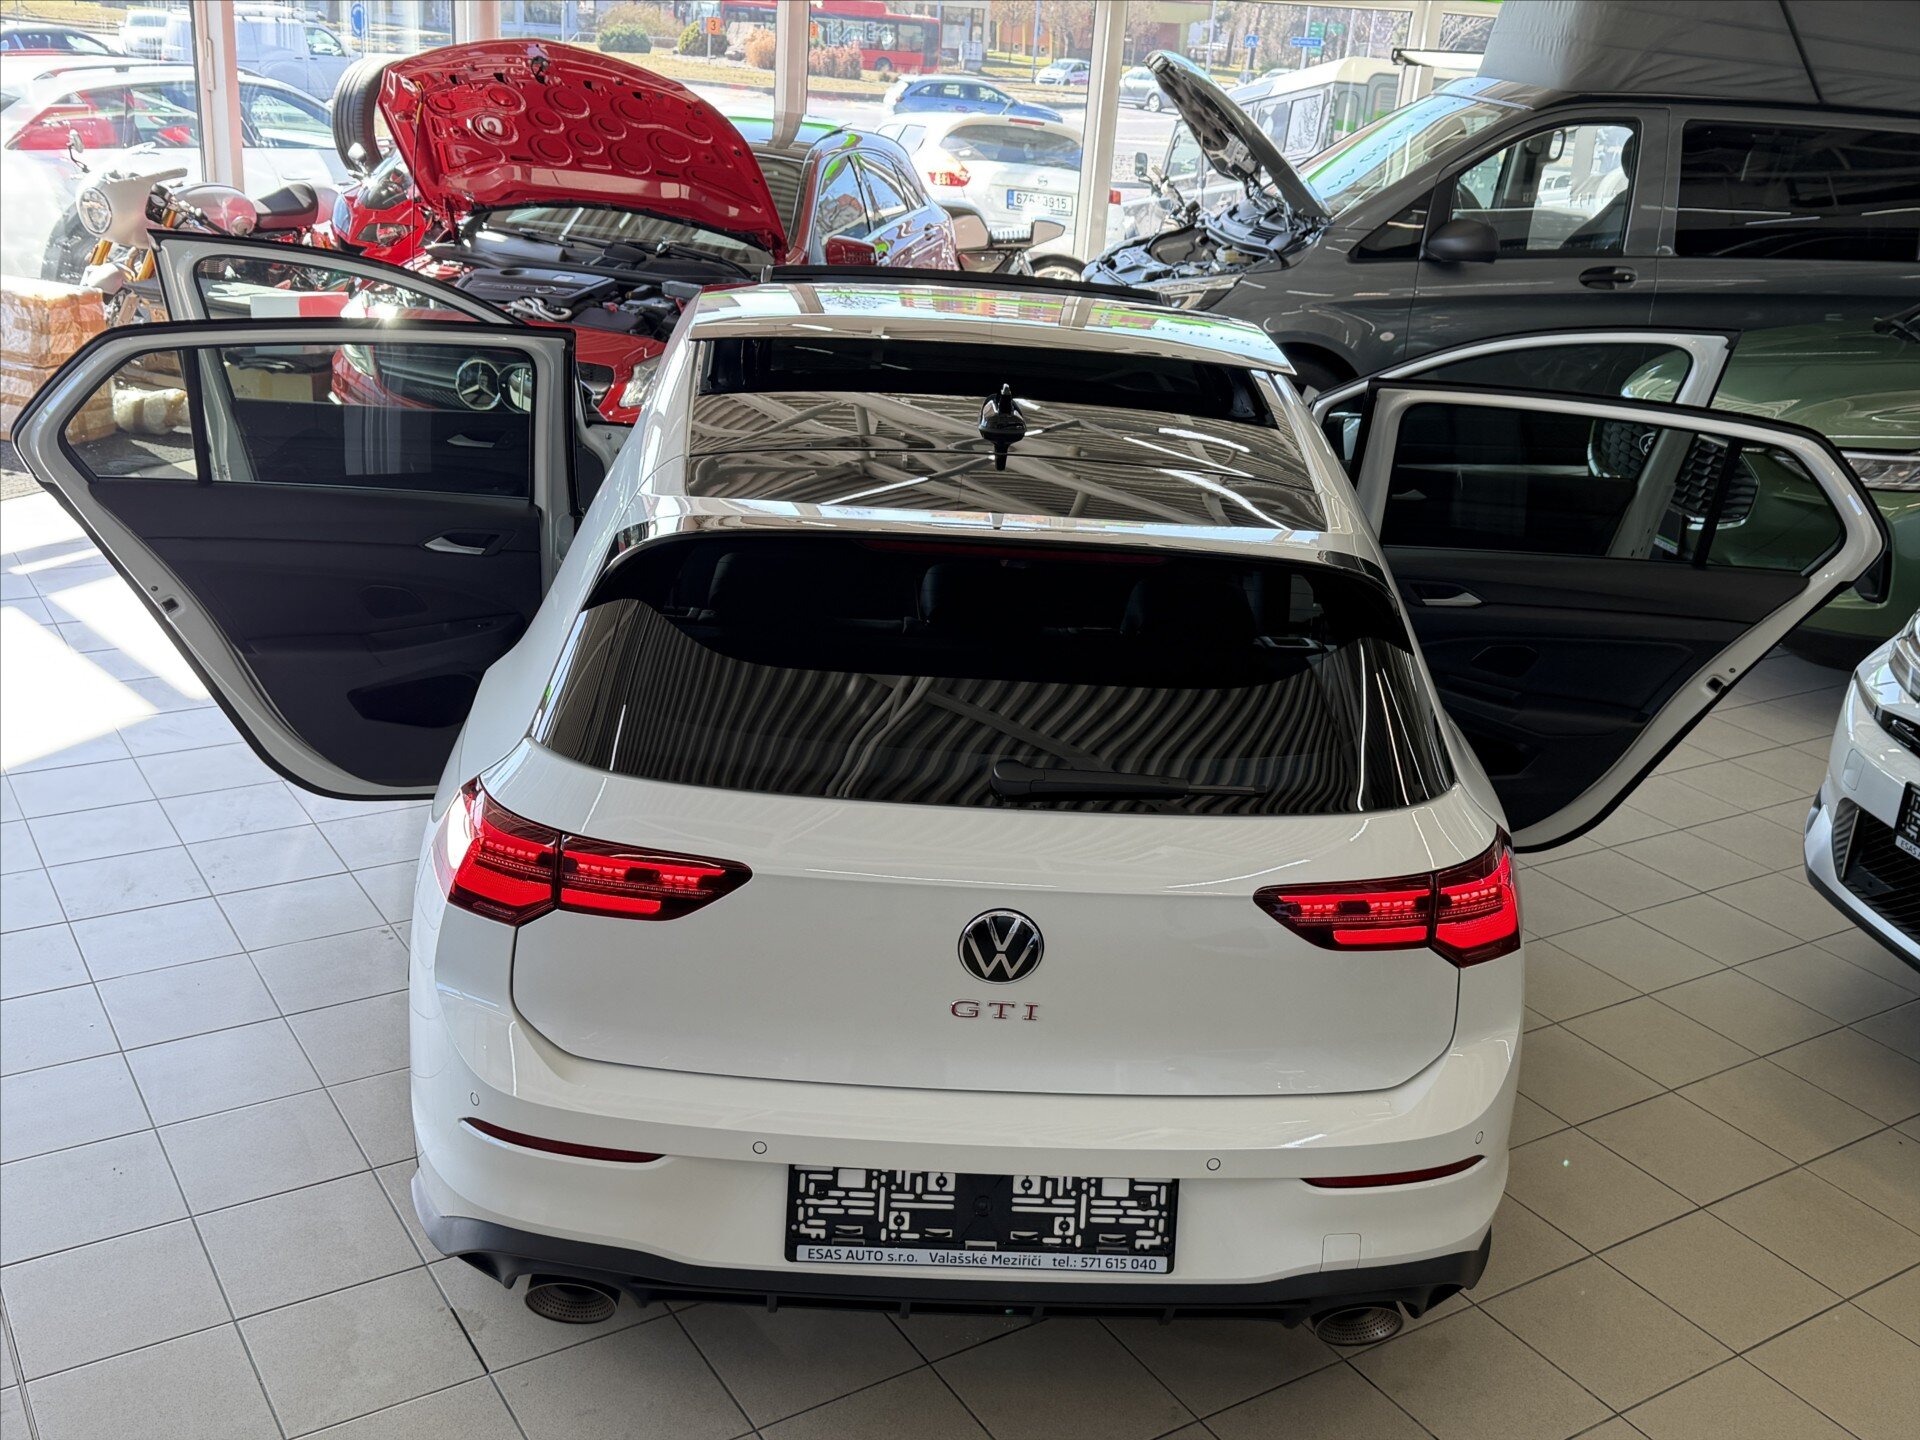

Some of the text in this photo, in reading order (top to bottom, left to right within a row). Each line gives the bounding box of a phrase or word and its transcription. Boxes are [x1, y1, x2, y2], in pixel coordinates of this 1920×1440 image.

[710, 19, 717, 31] 3
[1900, 840, 1917, 855] ESAS
[951, 999, 1039, 1021] GTI
[807, 1248, 1157, 1271] ESAS AUTO s.r.o. Valašské Meziříčí tel.: 571 615 040
